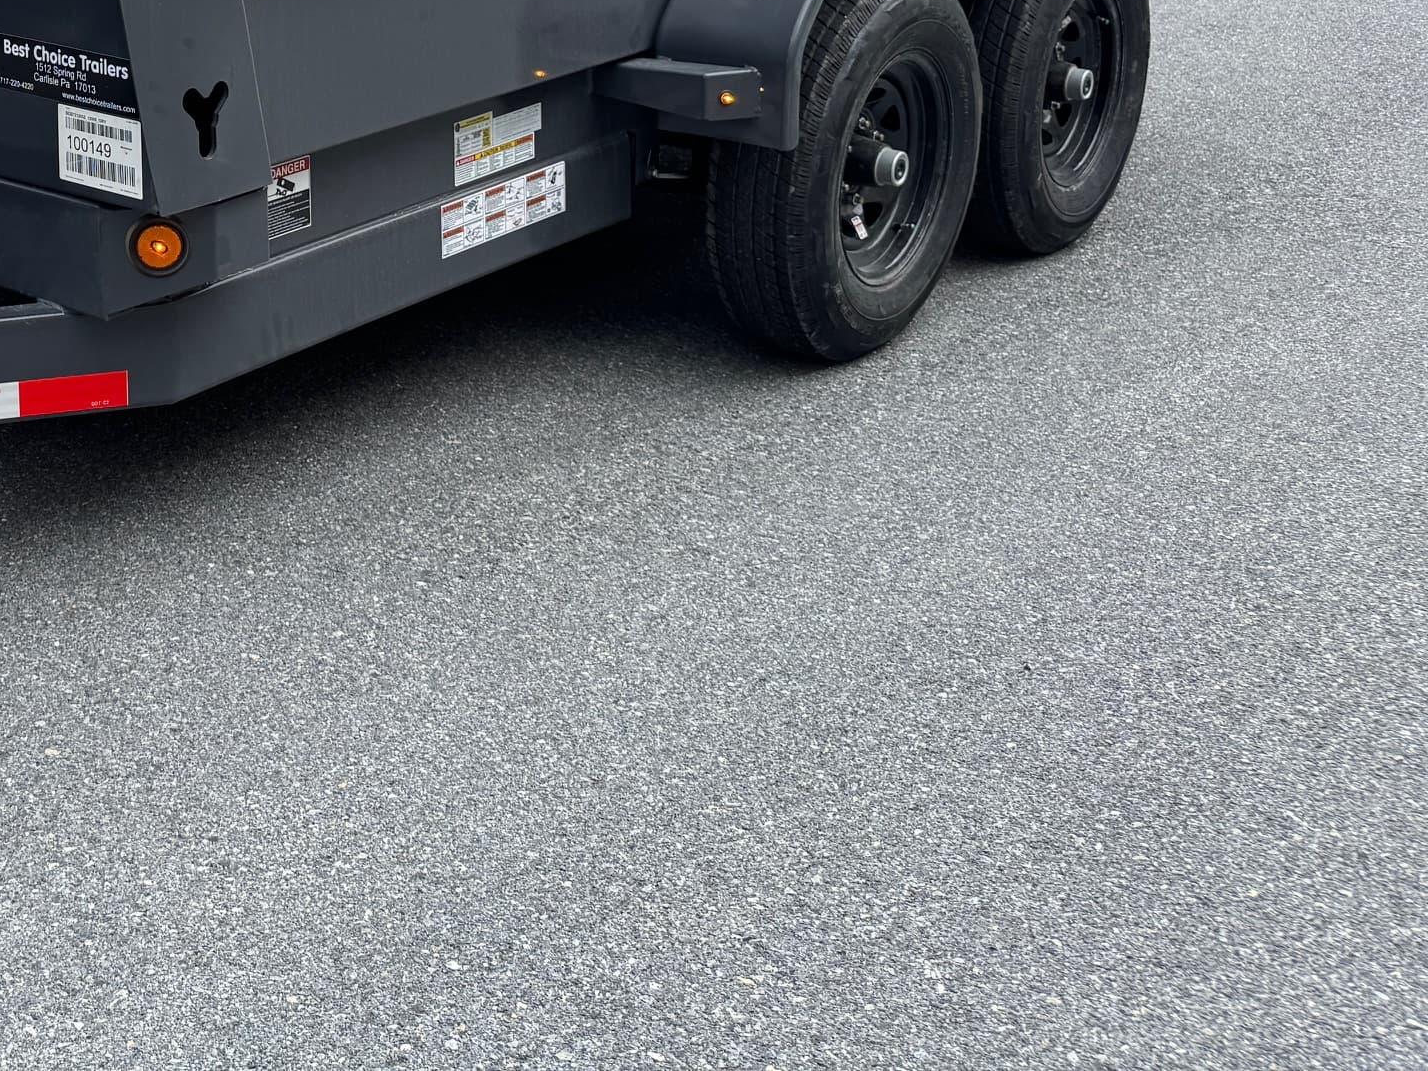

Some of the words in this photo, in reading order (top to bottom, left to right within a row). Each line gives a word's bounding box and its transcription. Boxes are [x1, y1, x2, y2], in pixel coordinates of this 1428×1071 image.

[3, 38, 30, 58] Best
[33, 45, 76, 68] Choice
[79, 54, 129, 80] Trailers
[33, 72, 59, 86] Carlisle
[60, 78, 71, 89] Pa
[74, 81, 96, 95] 17013
[35, 62, 52, 74] 1512
[53, 66, 75, 80] Spring
[76, 70, 87, 82] Rd
[61, 91, 136, 114] www.bestchoicetrailers.com
[67, 134, 112, 158] 100149
[270, 159, 306, 179] DANGER
